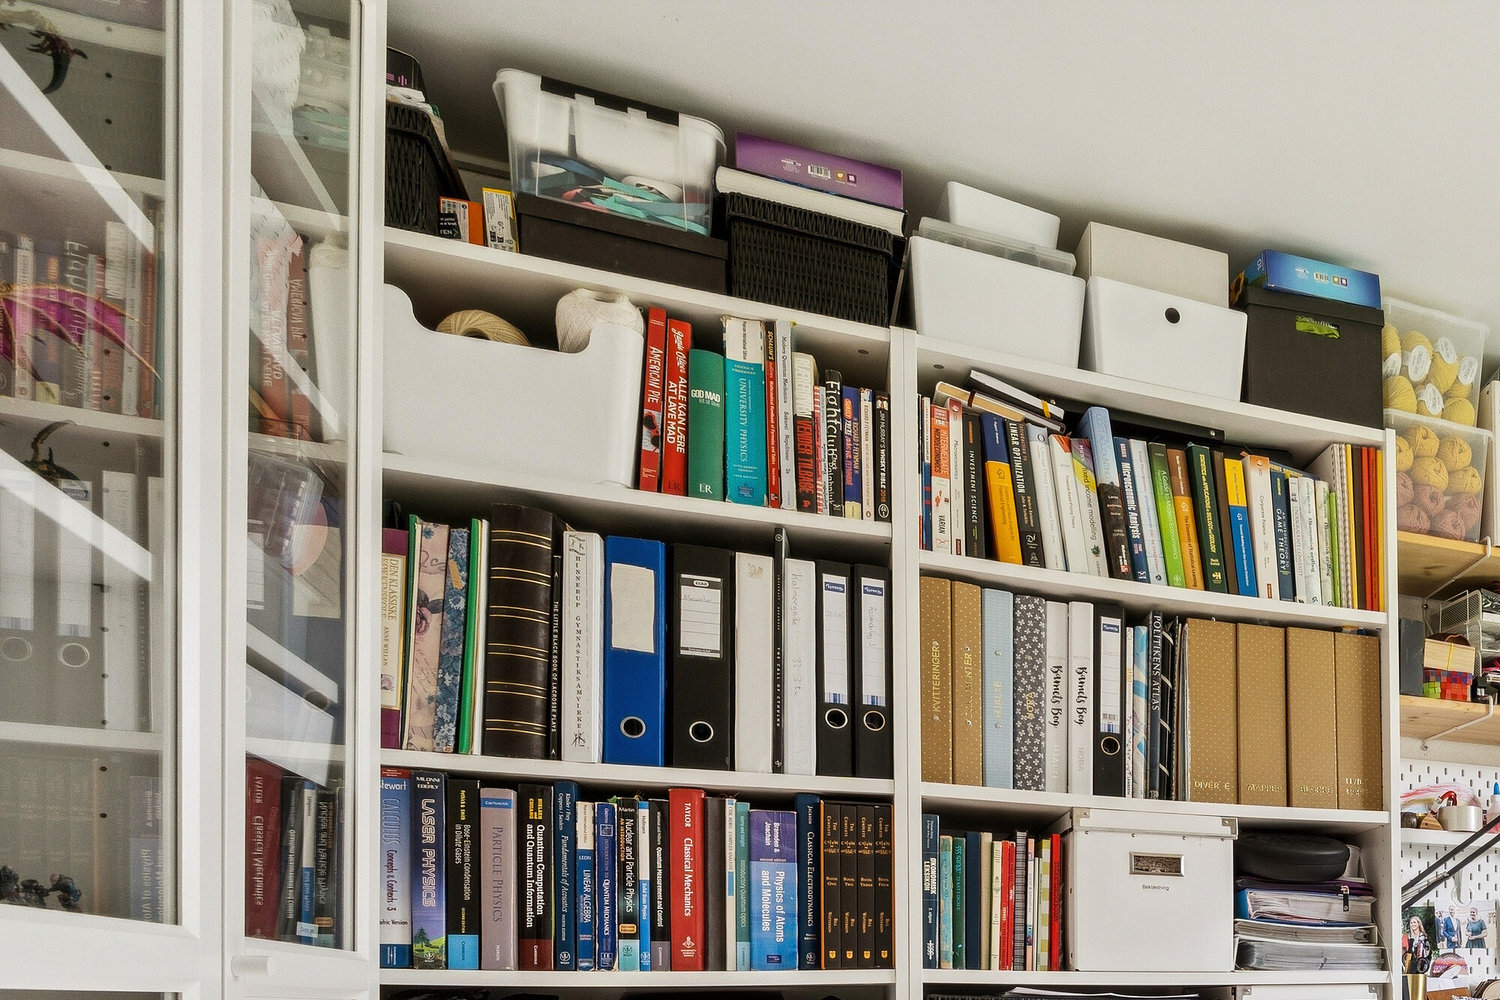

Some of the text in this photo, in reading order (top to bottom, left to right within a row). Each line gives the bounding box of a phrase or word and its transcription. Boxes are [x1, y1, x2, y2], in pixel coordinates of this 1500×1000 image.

[648, 347, 663, 403] AMERICAN PIE
[691, 389, 720, 403] GOD MAD
[667, 381, 677, 443] AT LAVE MAD
[677, 377, 686, 453] ALLE KAN LÆRE
[739, 378, 748, 462] UNIVERSITY PHYSICS
[797, 420, 814, 493] VENDER TILBAGE
[933, 427, 941, 473] MICROECONOMICS
[941, 430, 949, 475] INTERMEDIATE
[1009, 423, 1025, 493] LINEAR OPTIMIZATION
[1084, 485, 1093, 508] income
[1121, 462, 1141, 538] Microeconomic Analysis
[1162, 476, 1170, 493] Guide
[1165, 500, 1174, 522] Modern
[938, 515, 946, 534] VARIAN
[1088, 510, 1097, 540] modelling
[1168, 523, 1178, 560] Econometrics
[1278, 537, 1286, 570] THEORY
[388, 559, 399, 620] DEN KLASSISKE
[1153, 615, 1161, 676] POLITIKENS
[932, 645, 940, 712] KVITTERINGER
[1026, 692, 1035, 720] NORA
[1051, 666, 1063, 728] Barnets Bog
[1075, 667, 1087, 727] Barnets Bog
[1194, 781, 1230, 790] DIVERE
[382, 798, 401, 844] CALCULUS
[422, 799, 436, 907] LASER PHYSICS
[493, 827, 503, 922] PARTICLE PHYSICS
[525, 824, 534, 927] and Quantum Information
[536, 825, 545, 915] Quantum Computation
[561, 835, 569, 877] Fundamentals
[626, 819, 634, 912] Nuclear and Particle Physics
[684, 838, 693, 916] Classical Mechanics
[762, 871, 771, 931] and Molecules
[775, 871, 785, 942] Physics of Atoms
